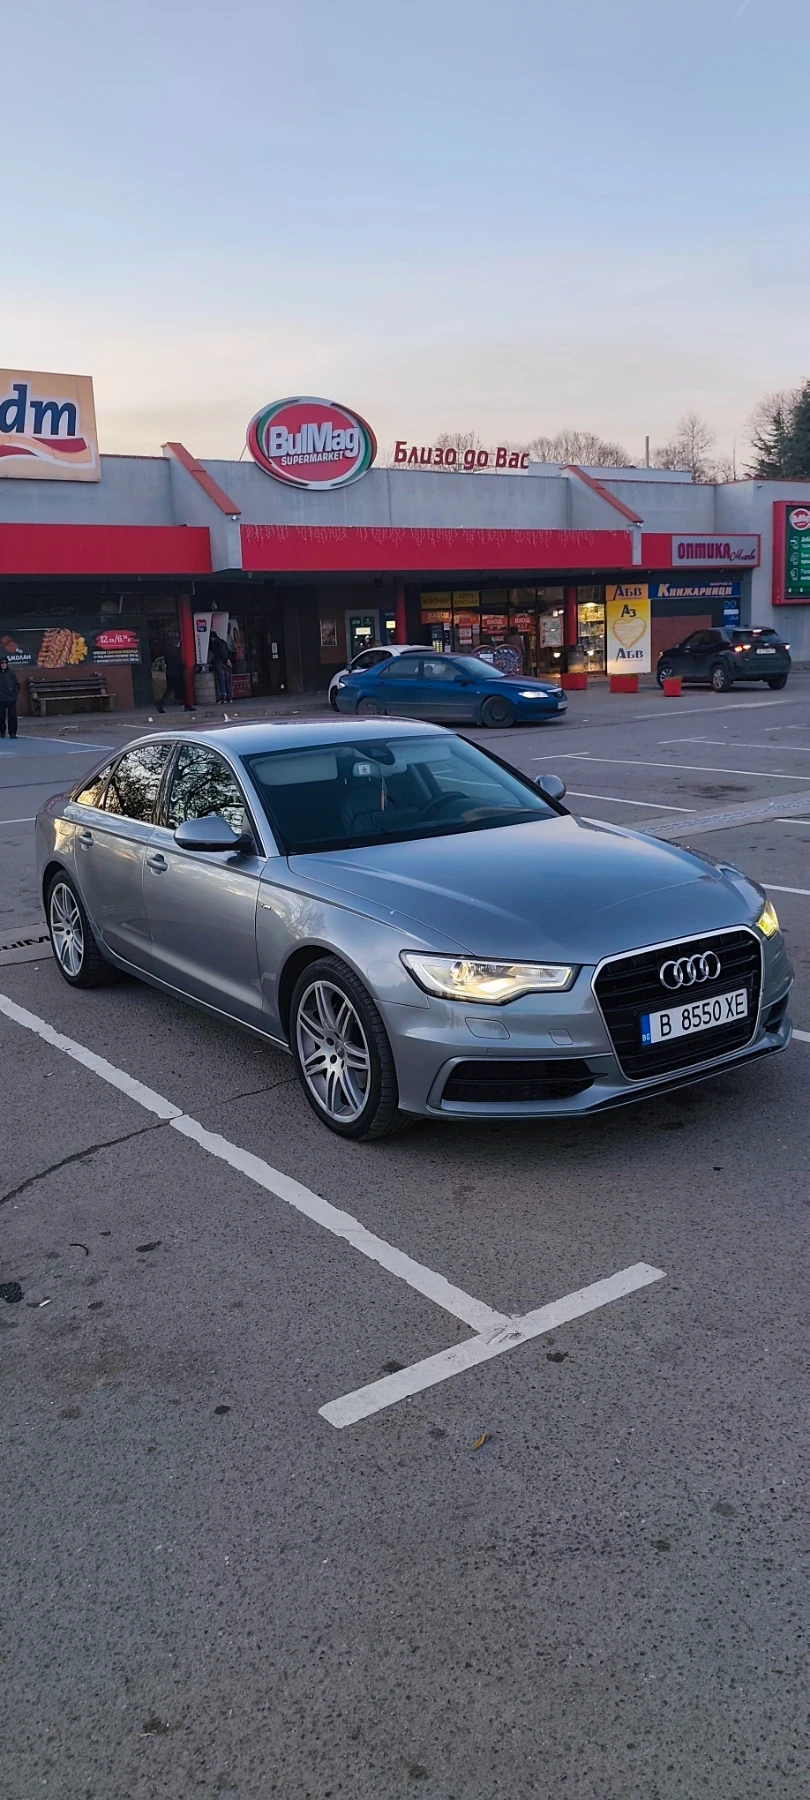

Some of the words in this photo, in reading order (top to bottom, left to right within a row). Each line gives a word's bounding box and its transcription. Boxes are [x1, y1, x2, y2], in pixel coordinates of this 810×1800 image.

[0, 384, 77, 436] dm
[269, 421, 359, 458] BulMag
[394, 441, 457, 465] Близо
[464, 449, 489, 469] до
[495, 447, 530, 469] Вас
[281, 451, 344, 466] SUPERMARKET
[660, 1013, 672, 1038] B
[681, 1000, 723, 1030] 8550
[725, 992, 746, 1019] XE
